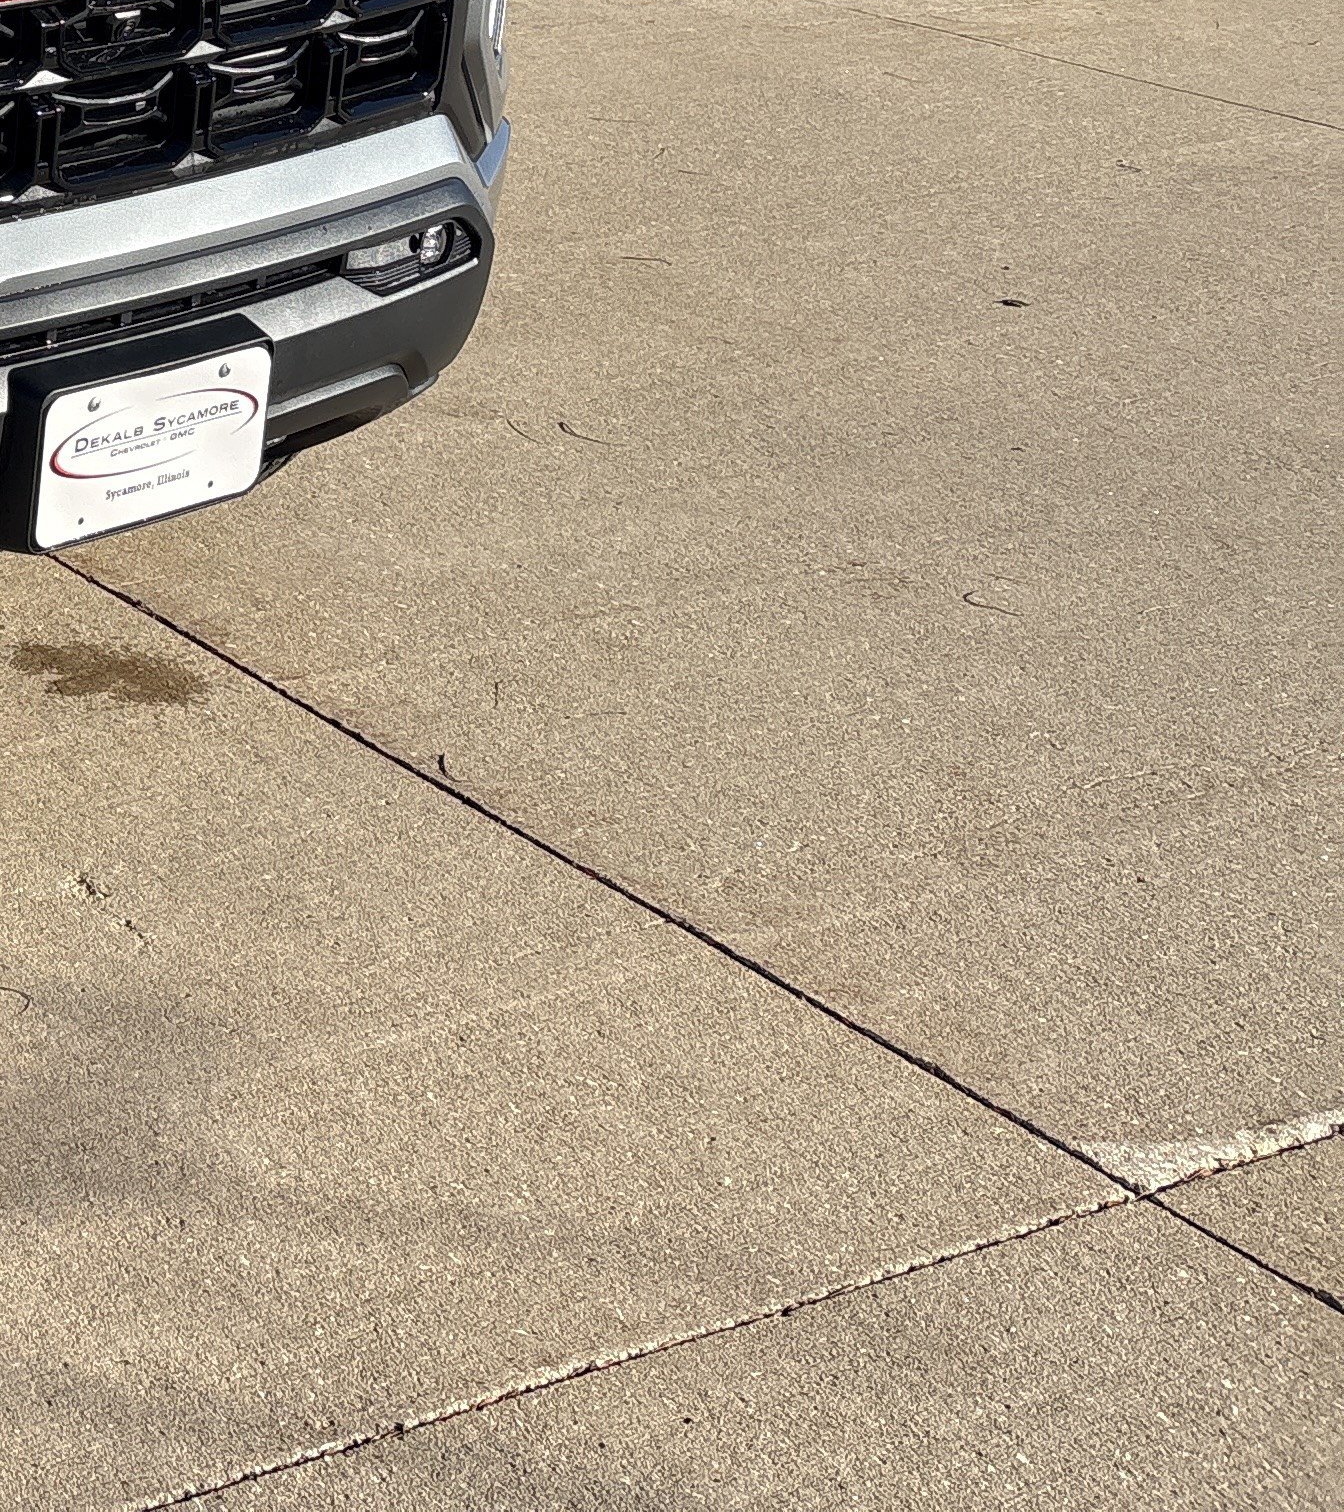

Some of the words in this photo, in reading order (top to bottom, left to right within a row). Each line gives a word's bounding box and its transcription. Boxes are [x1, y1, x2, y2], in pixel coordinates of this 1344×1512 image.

[153, 399, 240, 431] SYCAMORE
[169, 427, 195, 441] GMC
[105, 480, 155, 501] Sycamore,
[156, 468, 190, 486] Illinois
